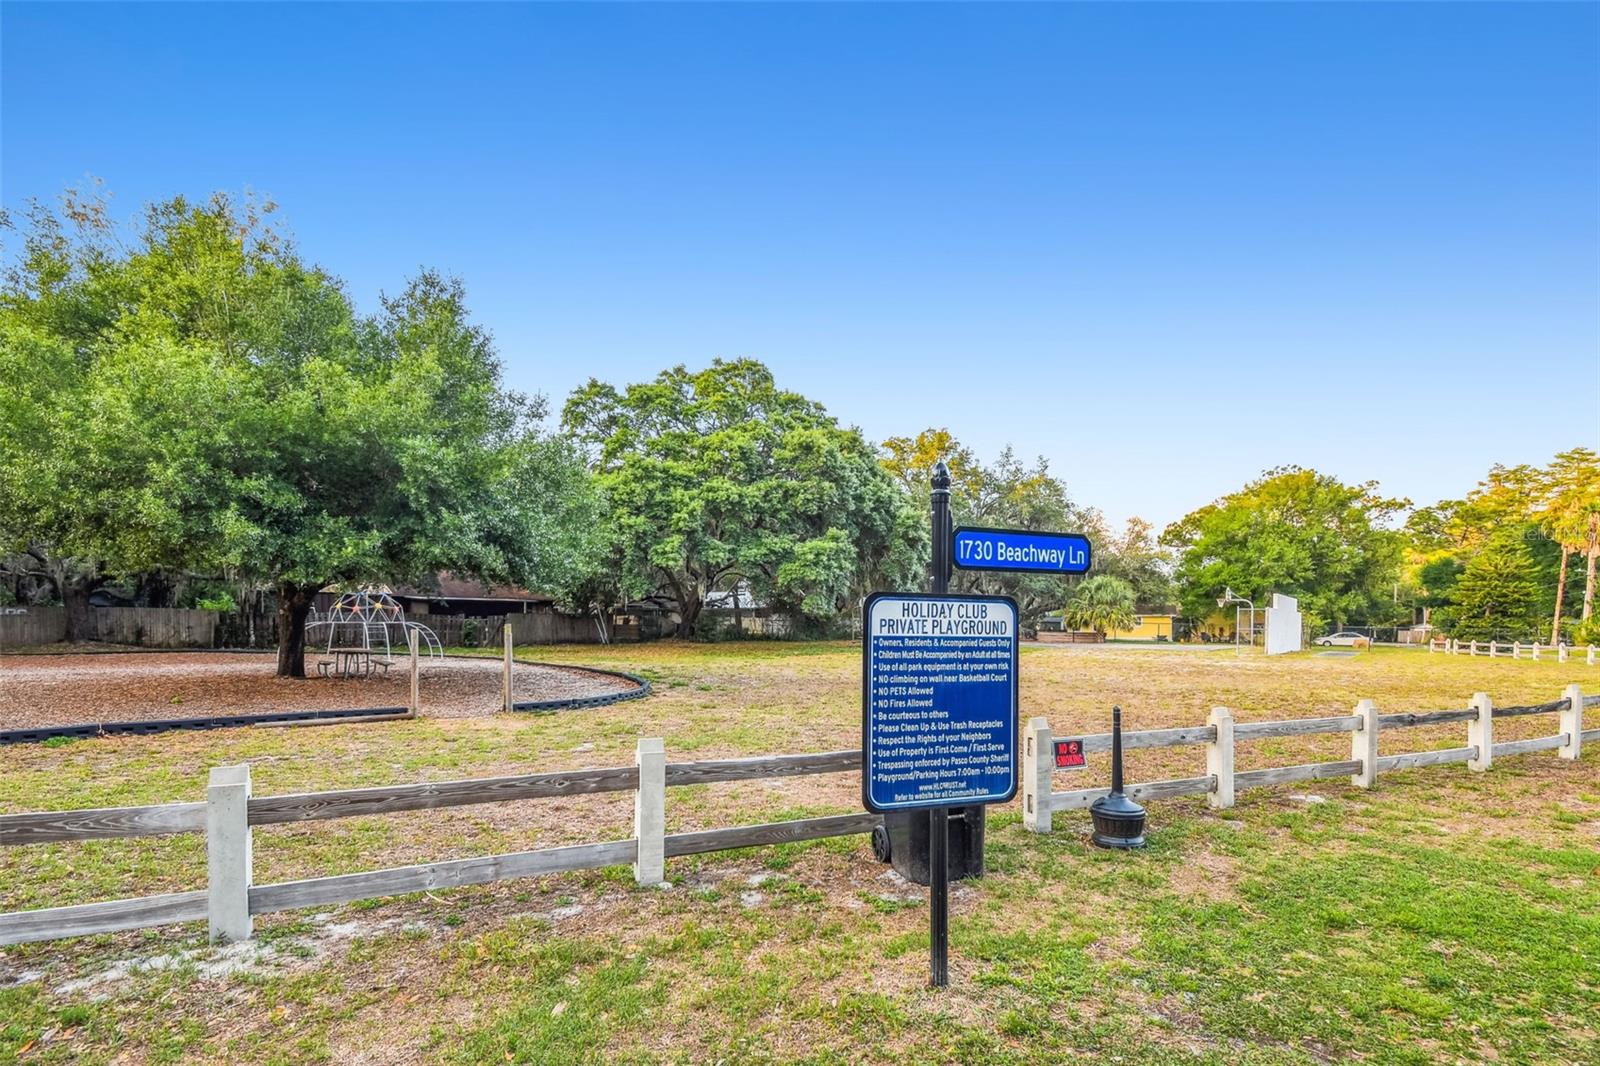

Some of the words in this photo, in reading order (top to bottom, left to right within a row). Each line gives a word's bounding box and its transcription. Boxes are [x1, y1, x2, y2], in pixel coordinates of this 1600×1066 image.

[960, 540, 992, 560] 1730
[997, 542, 1065, 568] Beachway
[1069, 545, 1085, 564] Ln
[902, 603, 954, 618] HOLIDAY
[958, 604, 987, 619] CLUB
[880, 619, 928, 634] PRIVATE
[932, 620, 1007, 635] PLAYGROUND
[940, 639, 978, 647] Accompanied
[998, 639, 1010, 648] Only
[923, 651, 960, 660] Accompanied
[960, 651, 965, 660] by
[908, 663, 922, 672] park
[924, 663, 956, 671] equipment
[890, 675, 918, 684] climbing
[959, 674, 989, 682] Basketball
[878, 687, 888, 695] NO
[890, 687, 907, 695] PETS
[908, 686, 934, 695] Allowed
[878, 700, 888, 708] NO
[890, 699, 905, 707] Fires
[907, 699, 932, 707] Allowed
[878, 712, 887, 720] Be
[901, 724, 919, 732] Clean
[920, 723, 929, 732] Up
[951, 721, 966, 729] Trash
[968, 720, 1003, 729] Receptacles
[878, 736, 903, 746] Respect
[905, 736, 915, 744] the
[917, 734, 937, 744] Rights
[945, 734, 960, 743] your
[961, 732, 991, 742] Neighbors
[878, 749, 890, 757] Use
[892, 748, 898, 756] of
[900, 747, 927, 757] Property
[935, 746, 949, 754] First
[950, 745, 967, 753] Come
[973, 744, 987, 752] First
[1058, 743, 1067, 754] NO
[878, 761, 913, 770] Trespassing
[915, 758, 940, 767] enforced
[942, 758, 950, 767] by
[951, 756, 968, 765] Pasco
[969, 755, 990, 764] County
[991, 754, 1009, 762] Sheriff
[1056, 754, 1084, 766] SMOKING
[878, 769, 938, 783] Playground/Parking
[940, 769, 956, 777] Hours
[958, 768, 980, 776] 7:00am
[985, 766, 1009, 775] 10:00pm
[915, 792, 933, 800] website
[949, 789, 975, 798] Community
